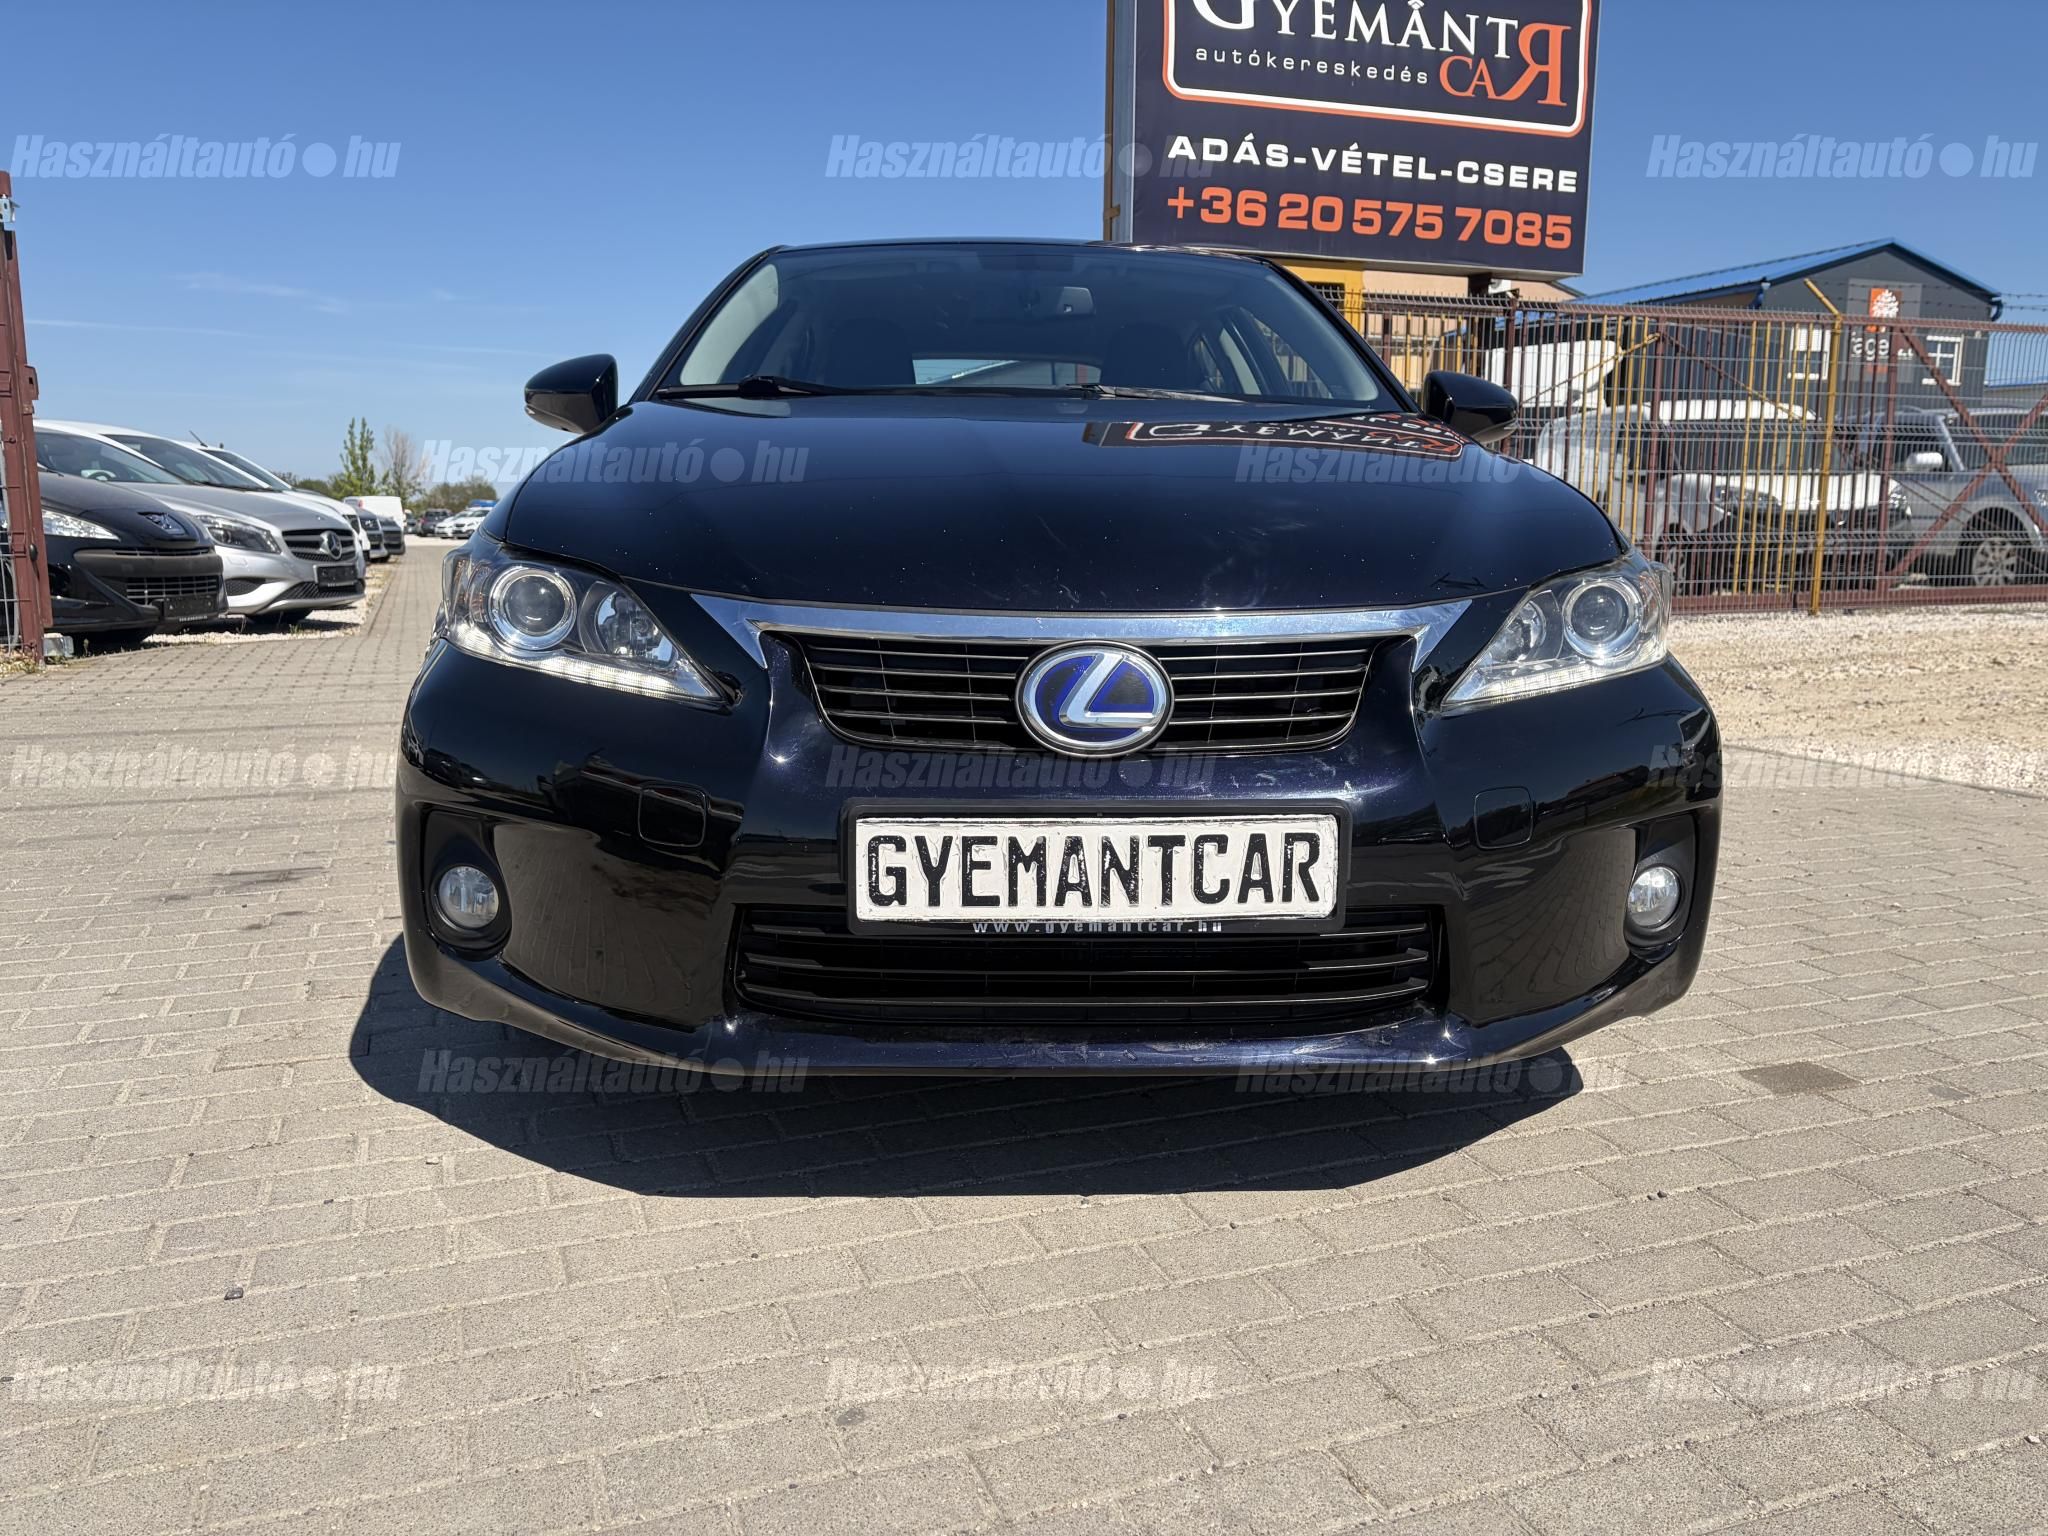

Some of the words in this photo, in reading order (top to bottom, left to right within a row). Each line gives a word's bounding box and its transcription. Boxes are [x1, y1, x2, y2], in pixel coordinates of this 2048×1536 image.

[1195, 46, 1429, 85] autókereskedés
[1167, 133, 1579, 193] ADÁS-VÉTEL-CSERE
[1167, 186, 1268, 227] +36
[1277, 193, 1344, 232] 20
[1351, 202, 1445, 240] 575
[1454, 208, 1573, 249] 7085
[867, 832, 1320, 907] GYEMANTCAR
